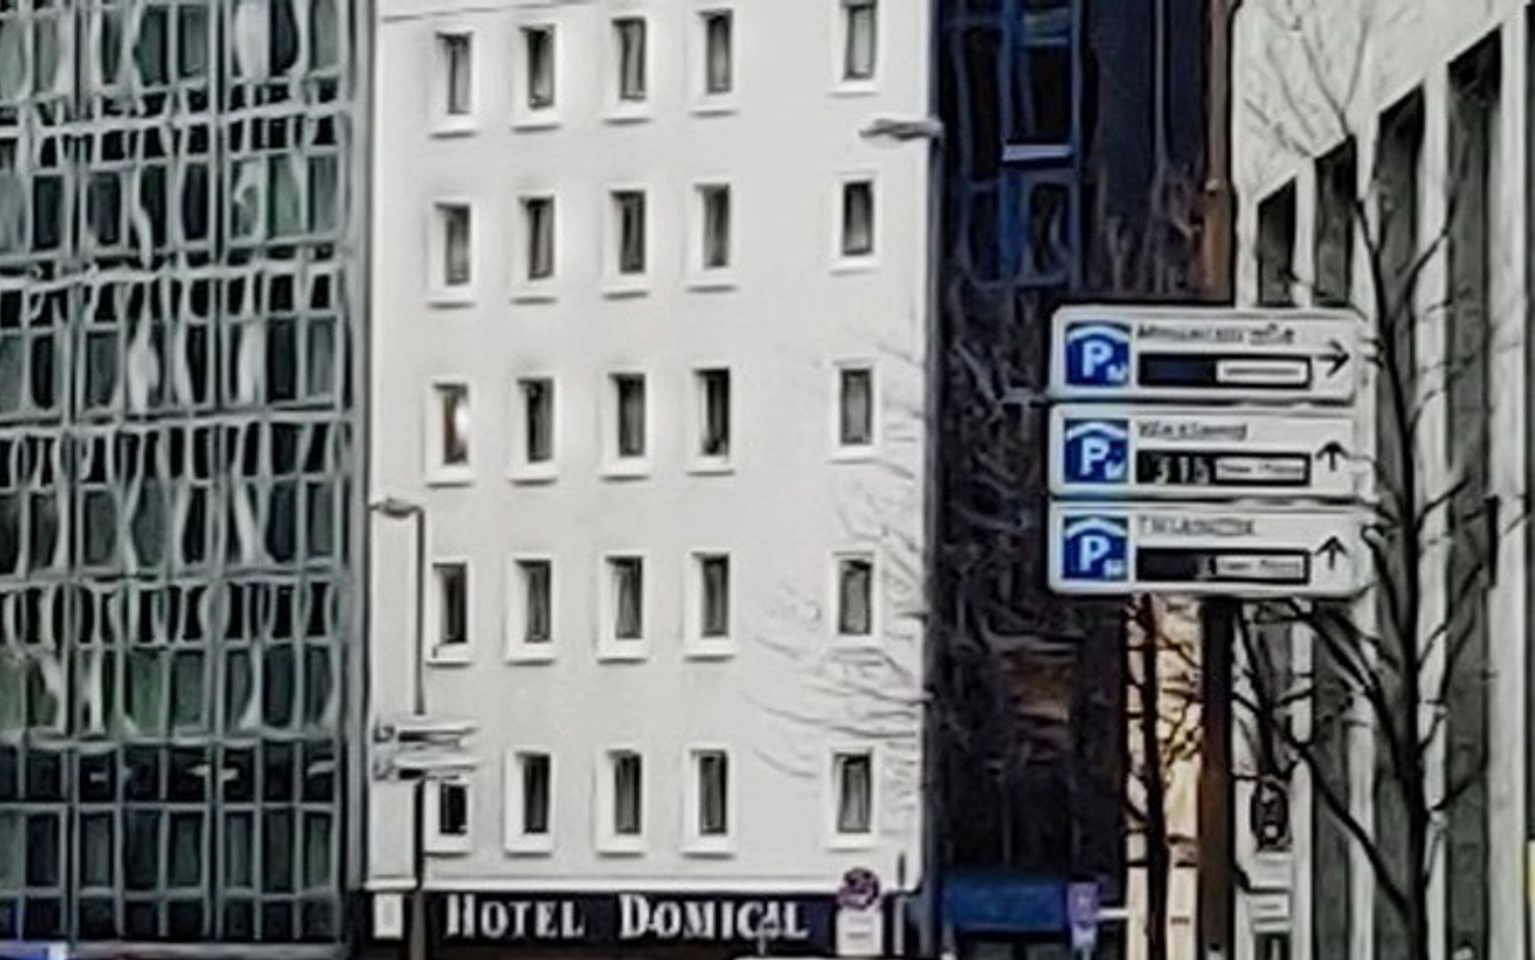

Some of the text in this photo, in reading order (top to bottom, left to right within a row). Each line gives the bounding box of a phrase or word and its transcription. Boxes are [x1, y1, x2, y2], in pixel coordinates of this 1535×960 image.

[1082, 339, 1115, 378] P
[1079, 437, 1110, 477] P
[1079, 534, 1110, 572] P
[445, 893, 585, 939] HOTEL
